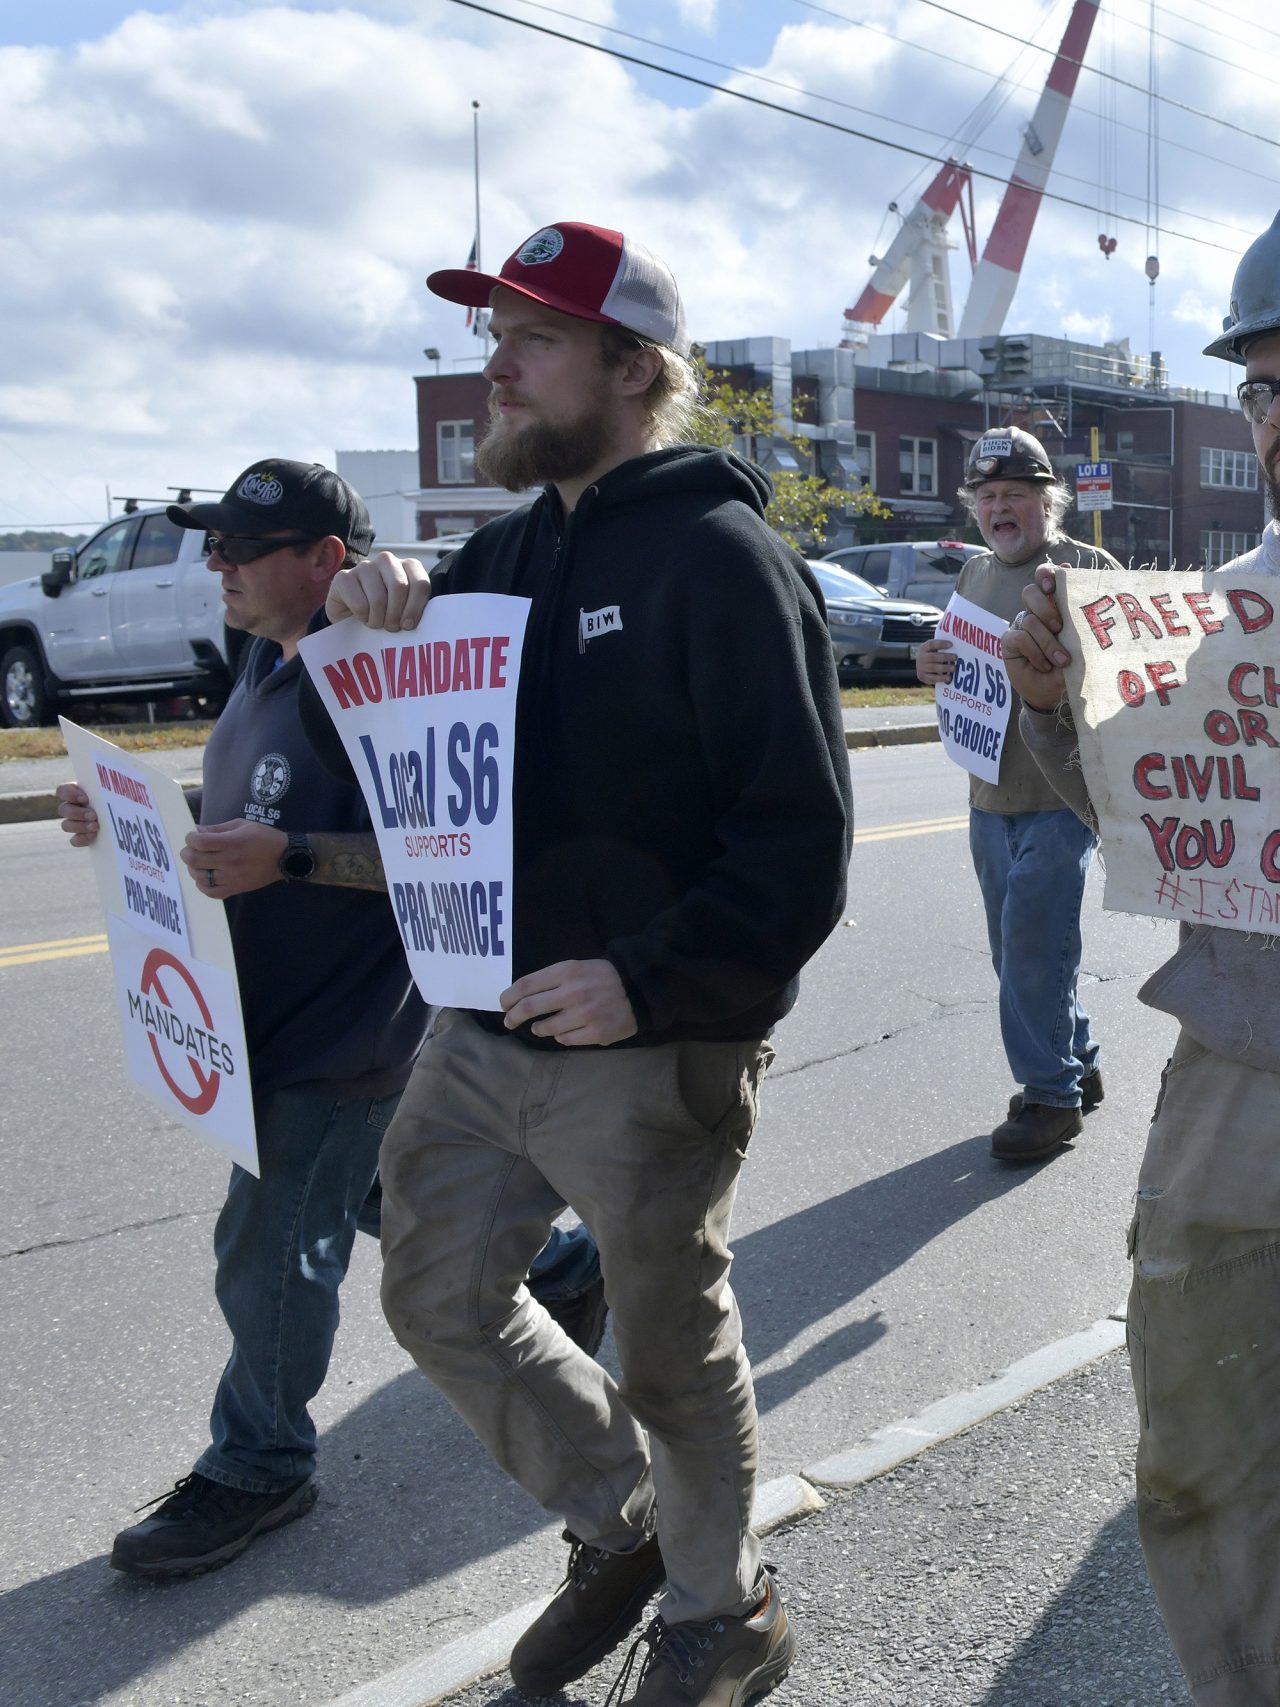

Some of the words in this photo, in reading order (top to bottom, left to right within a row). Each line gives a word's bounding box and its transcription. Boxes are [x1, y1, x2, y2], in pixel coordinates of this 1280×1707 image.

[1078, 464, 1098, 477] LOT
[1100, 463, 1108, 475] B
[940, 611, 952, 634] O
[322, 652, 383, 709] NO
[942, 687, 993, 717] SUPPORTS
[945, 657, 979, 697] cal
[984, 663, 1006, 709] S6
[1117, 660, 1180, 708] OF
[96, 763, 111, 791] NO
[110, 769, 152, 809] MANDATE
[359, 727, 436, 829] Local
[447, 721, 500, 828] S6
[1133, 752, 1261, 801] CIVIL
[244, 803, 266, 817] LOCAL
[267, 808, 281, 820] S6
[107, 802, 147, 864] Local
[144, 817, 170, 872] S6
[405, 833, 471, 858] SUPPORTS
[1140, 813, 1236, 871] YOU
[128, 857, 165, 882] SUPPORTS
[124, 875, 182, 935] PRO-CHOICE
[393, 880, 505, 957] PRO-CHOICE
[127, 989, 234, 1076] MANDATES
